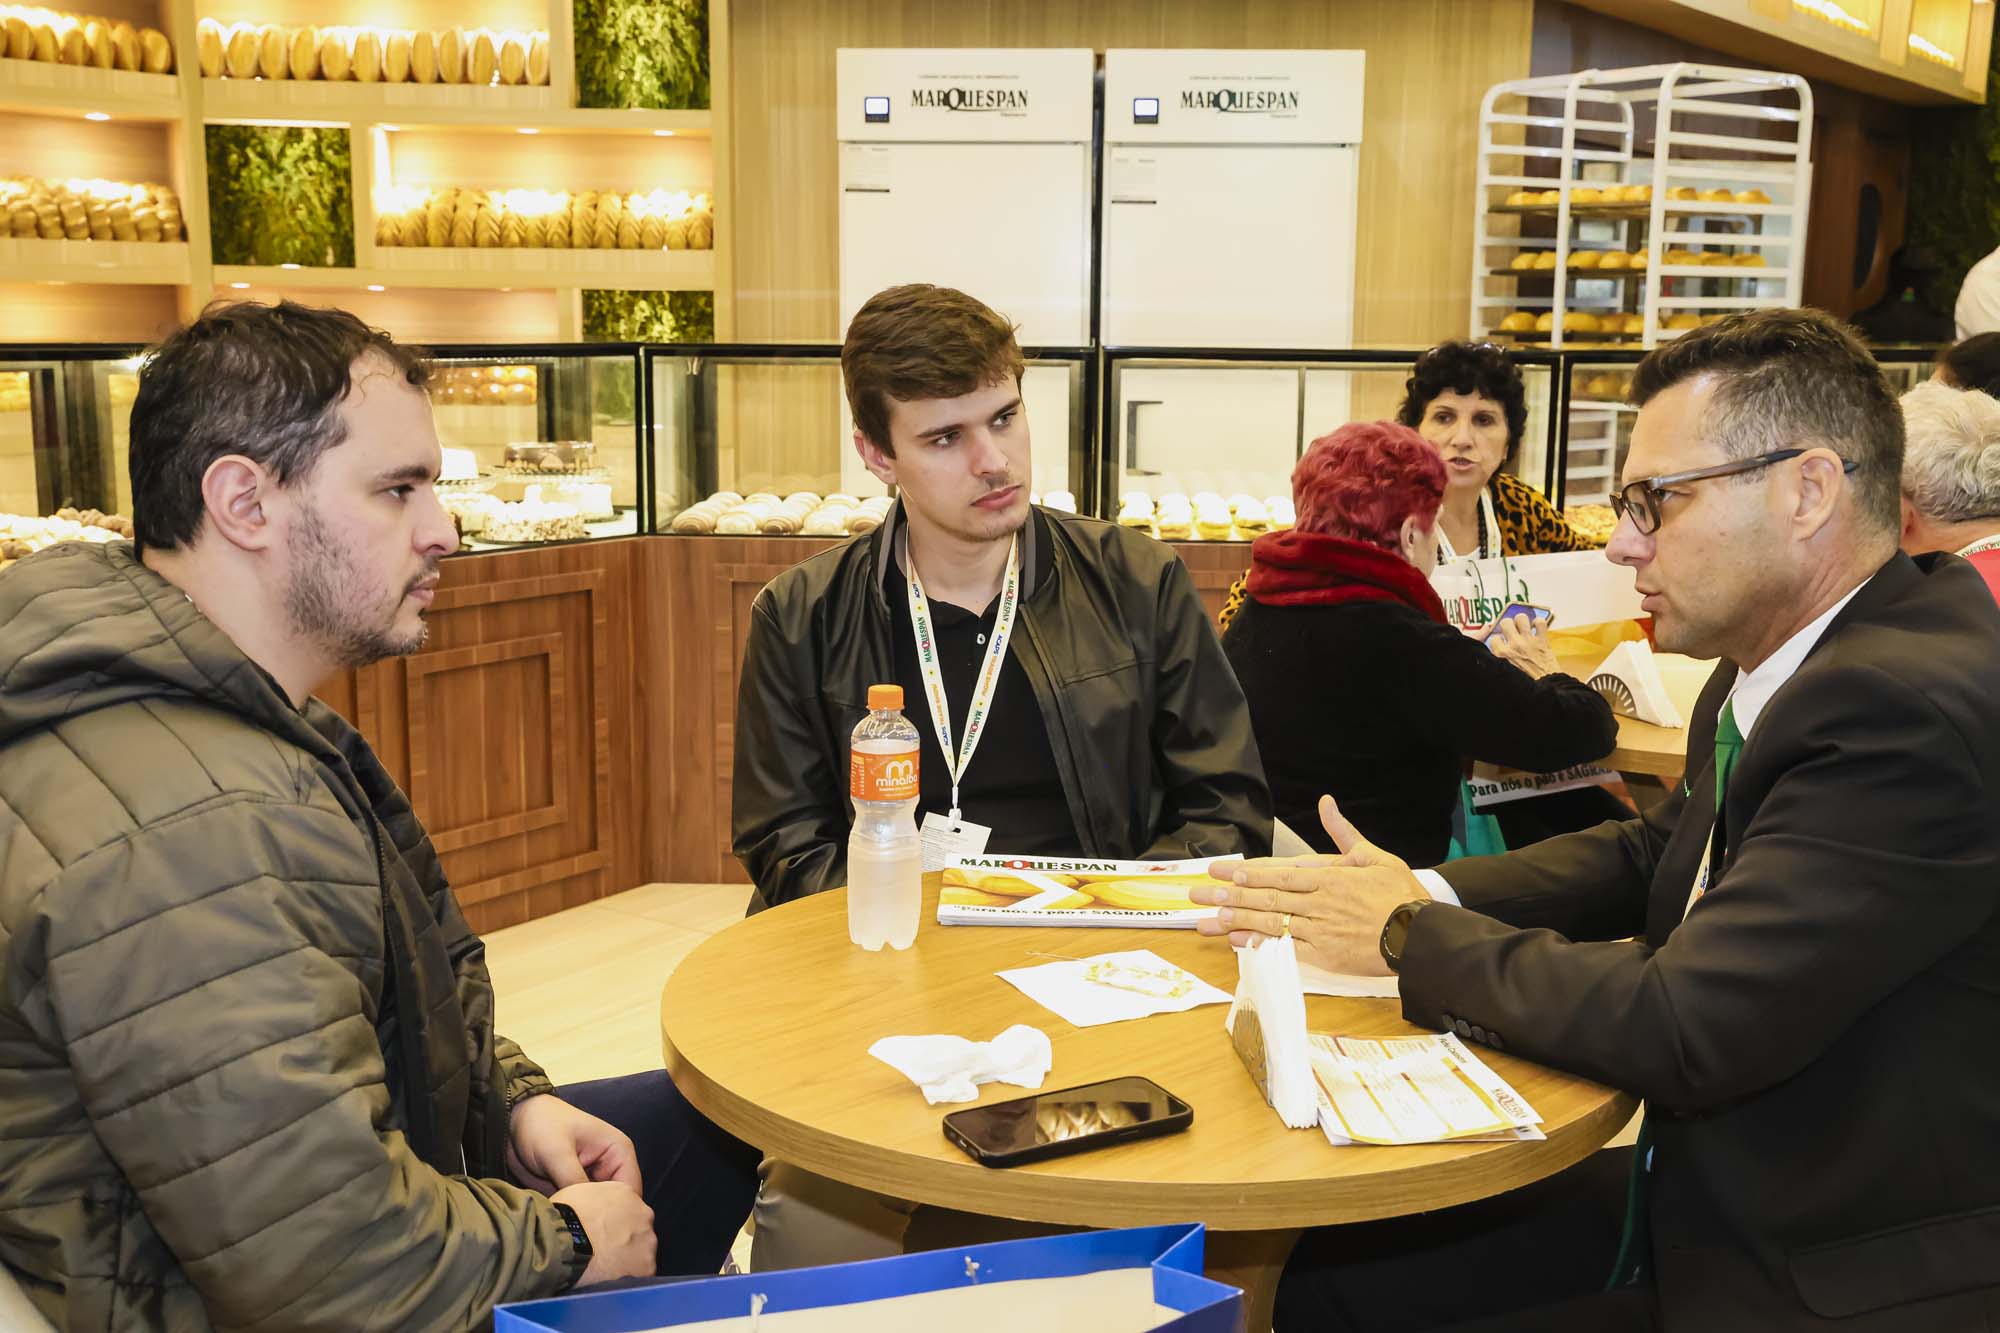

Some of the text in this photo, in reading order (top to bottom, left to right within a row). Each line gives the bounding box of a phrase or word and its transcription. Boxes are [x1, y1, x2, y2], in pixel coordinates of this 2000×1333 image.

[911, 88, 1028, 111] MARQUESPAN
[1181, 89, 1299, 113] MARQUESPAN
[918, 616, 932, 662] MARQUESPAN
[962, 710, 982, 755] MARQUESPAN
[960, 858, 1117, 872] MARQUESPAN
